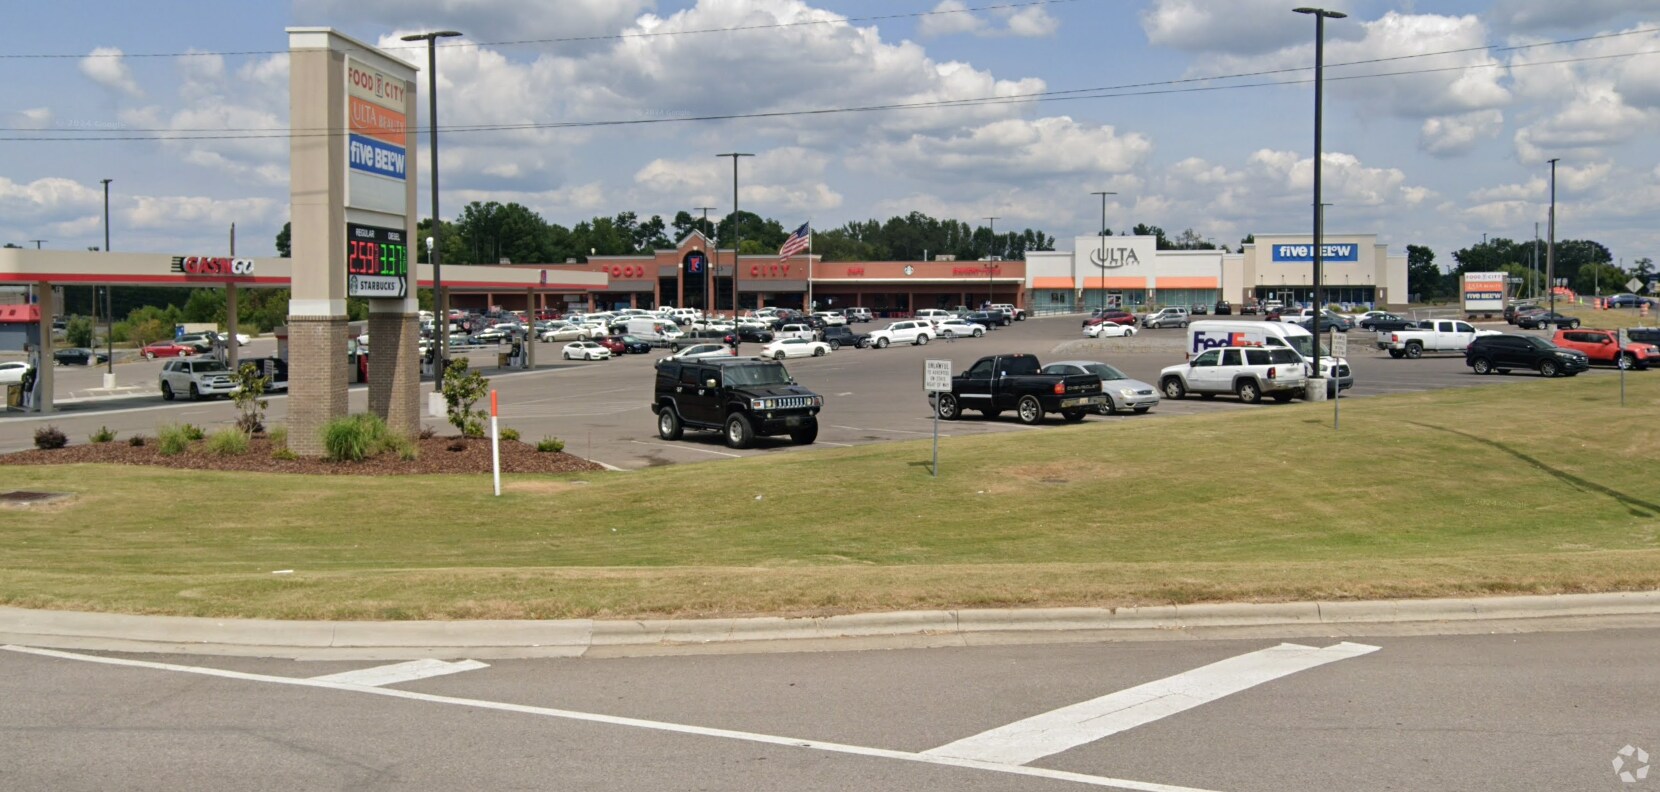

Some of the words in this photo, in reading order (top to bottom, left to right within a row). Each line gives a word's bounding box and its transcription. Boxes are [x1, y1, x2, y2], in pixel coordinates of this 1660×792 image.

[384, 82, 404, 102] CITY
[351, 101, 377, 128] ULTA
[356, 228, 375, 238] REGULAR
[1095, 247, 1140, 265] ULTA
[1279, 245, 1308, 257] five
[360, 281, 395, 290] STARBUCKS
